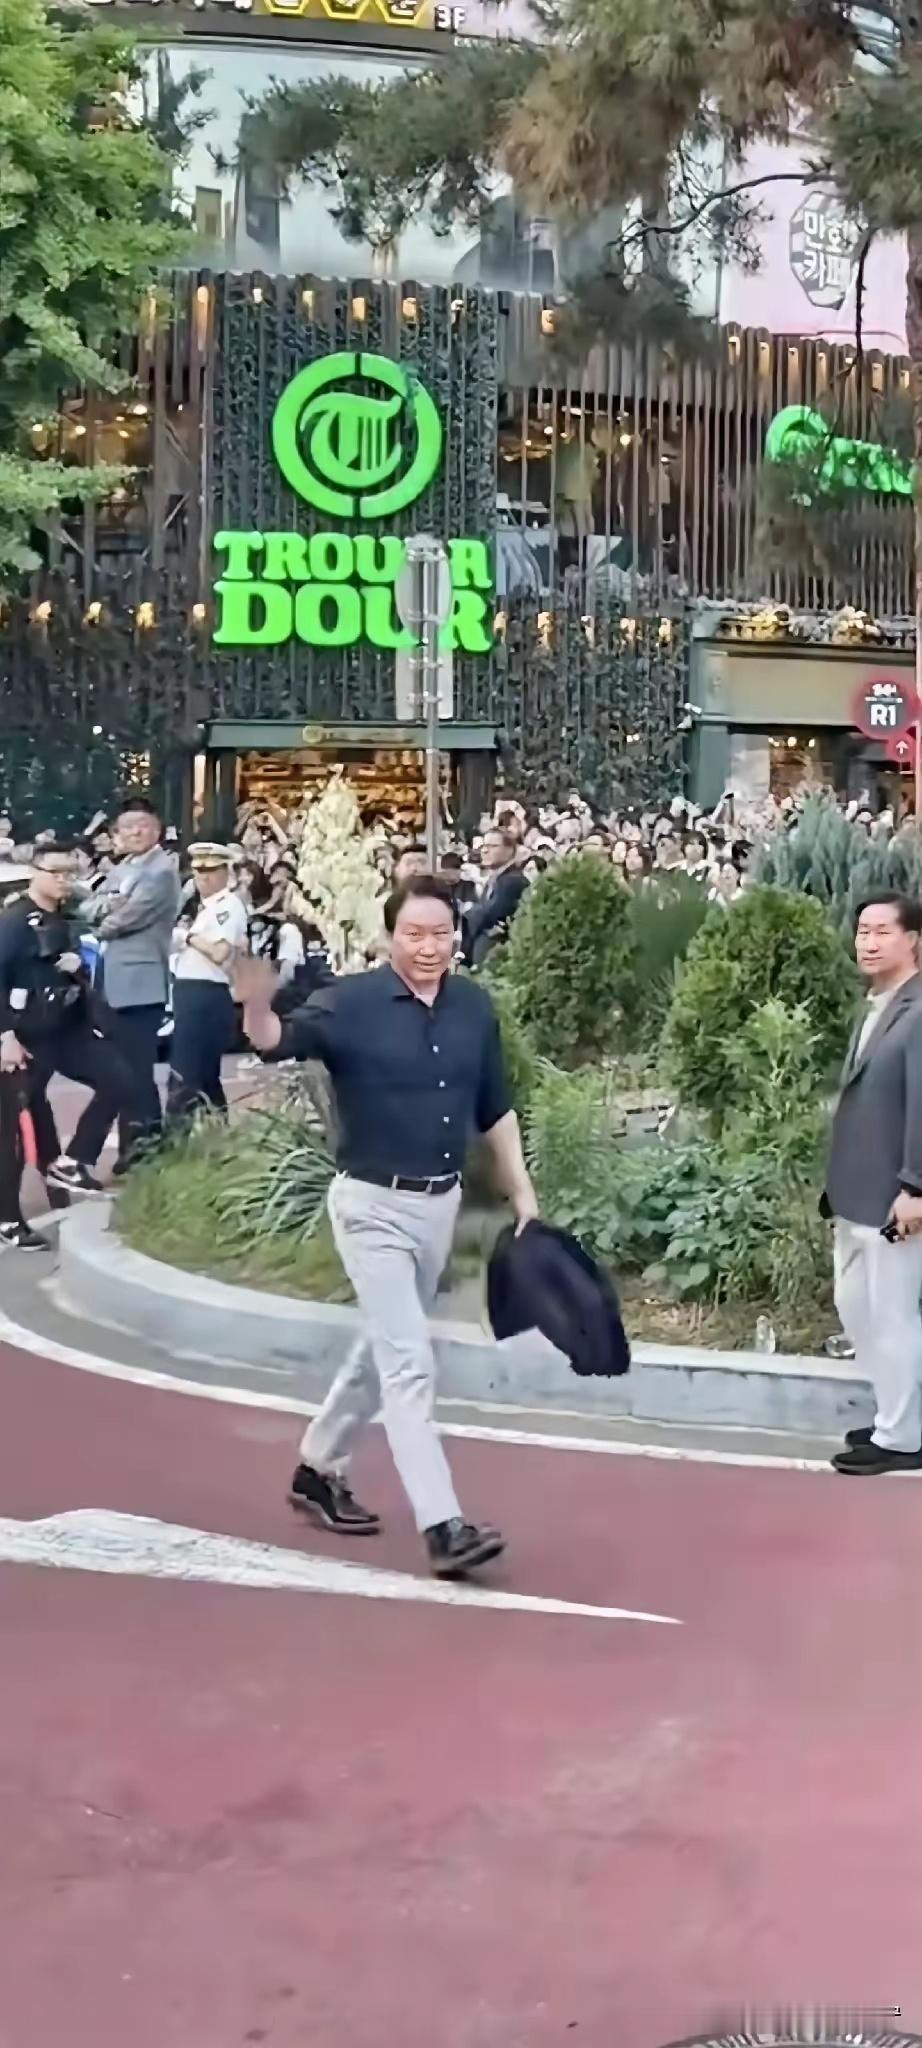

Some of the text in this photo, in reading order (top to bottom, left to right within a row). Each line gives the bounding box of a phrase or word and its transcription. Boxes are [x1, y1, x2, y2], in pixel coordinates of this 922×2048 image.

[438, 5, 465, 29] 3F
[213, 531, 492, 589] TROUA
[870, 703, 897, 726] R1
